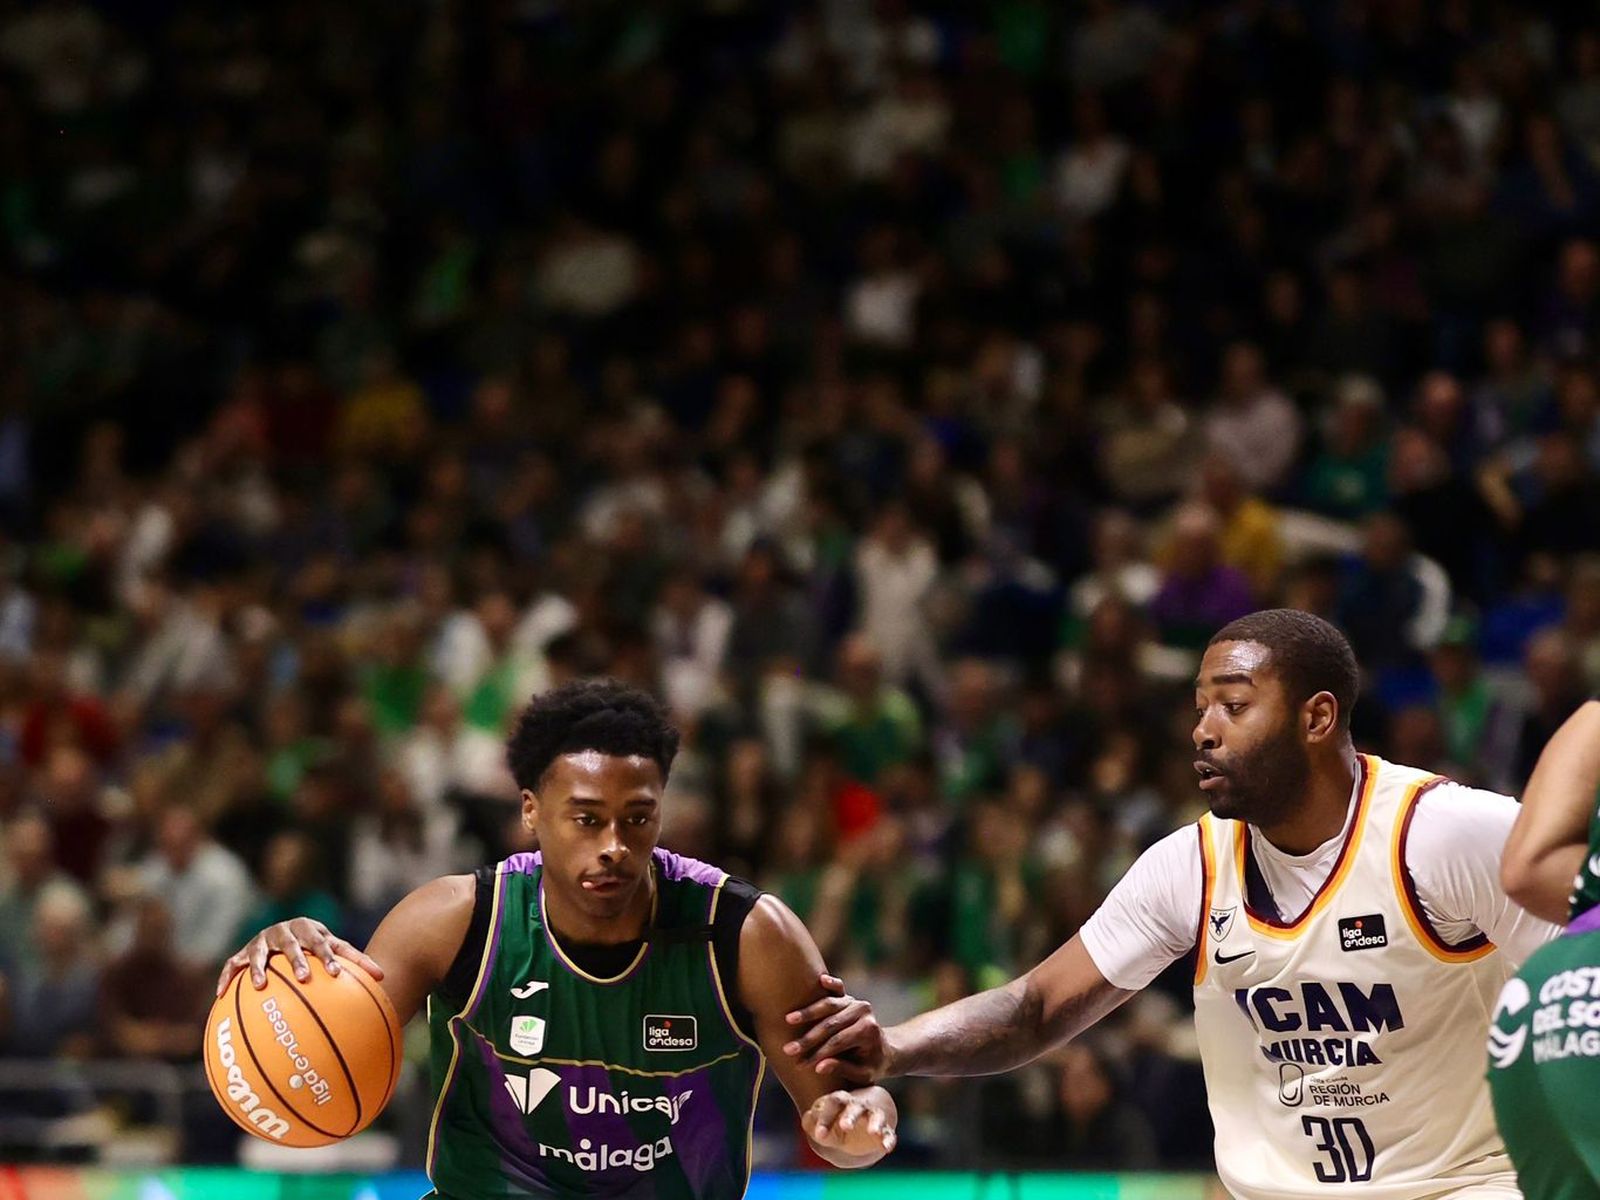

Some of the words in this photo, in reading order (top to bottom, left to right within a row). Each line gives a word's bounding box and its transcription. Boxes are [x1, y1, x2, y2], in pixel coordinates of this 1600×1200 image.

[1342, 927, 1362, 939] liga
[1344, 935, 1385, 948] endesa
[649, 1026, 669, 1038] liga
[649, 1036, 693, 1046] endesa
[1260, 1038, 1383, 1067] MURCIA
[1309, 1083, 1361, 1095] REGIÓN
[1313, 1095, 1331, 1106] DE
[1334, 1093, 1390, 1107] MURCIA
[1301, 1114, 1375, 1183] 30
